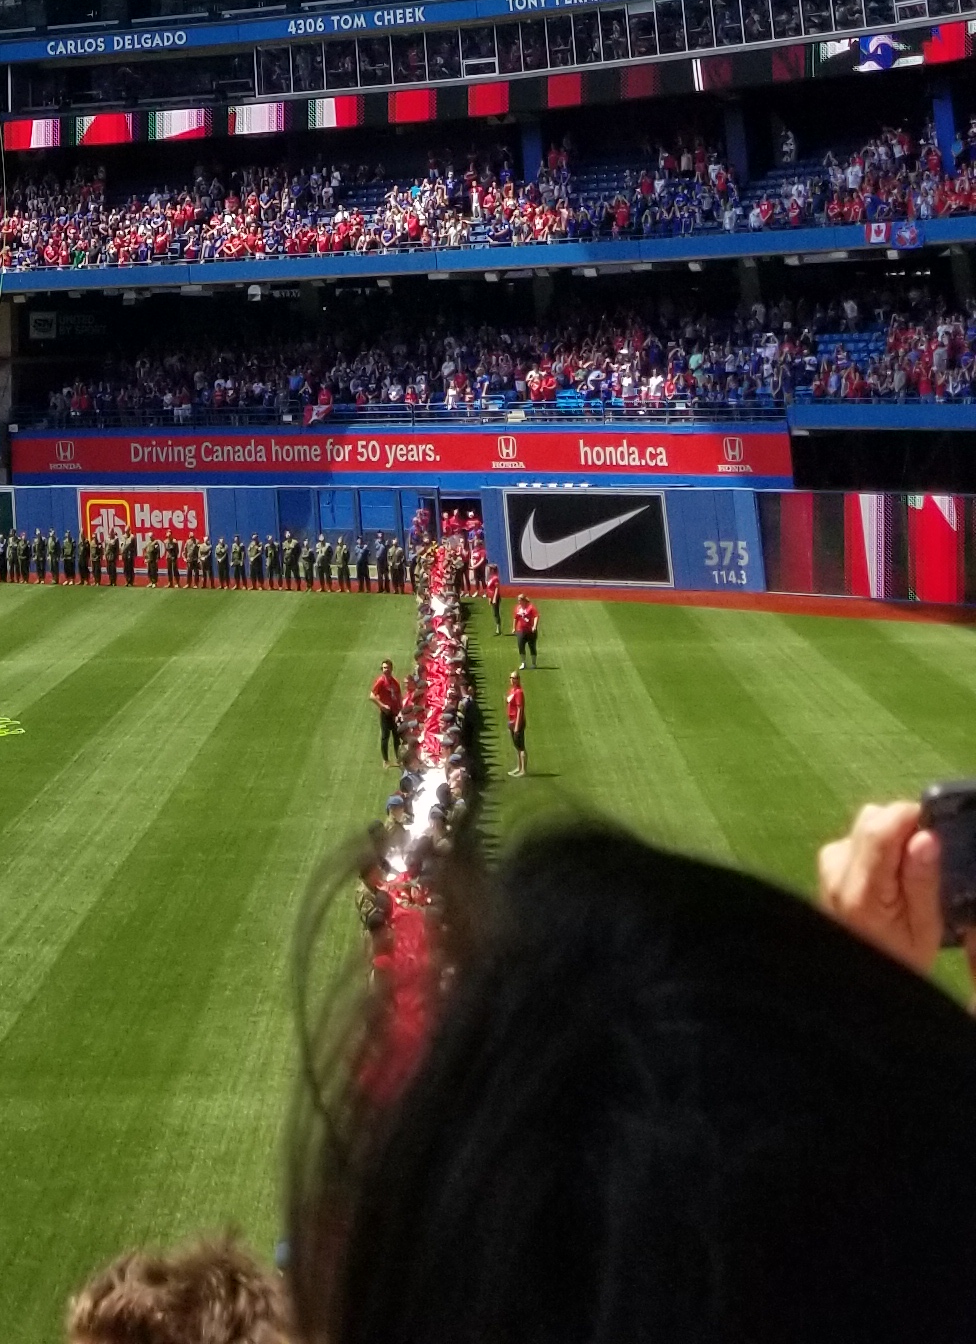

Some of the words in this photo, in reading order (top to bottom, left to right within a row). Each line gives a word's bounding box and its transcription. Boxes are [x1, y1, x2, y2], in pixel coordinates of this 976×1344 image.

[287, 17, 325, 35] 4306
[331, 14, 366, 31] TOM
[373, 7, 426, 27] CHEEK
[47, 38, 106, 56] CARLOS
[113, 31, 187, 51] DELGADO
[130, 440, 197, 468] Driving
[201, 440, 266, 462] Canada
[271, 441, 322, 462] home
[325, 440, 352, 462] for
[356, 440, 381, 462] 50
[385, 443, 441, 468] years.
[492, 461, 526, 469] HONDA
[579, 439, 668, 467] honda.ca
[717, 464, 753, 473] HONDA
[134, 503, 198, 529] Here's
[703, 540, 750, 566] 375
[712, 570, 747, 585] 114.3
